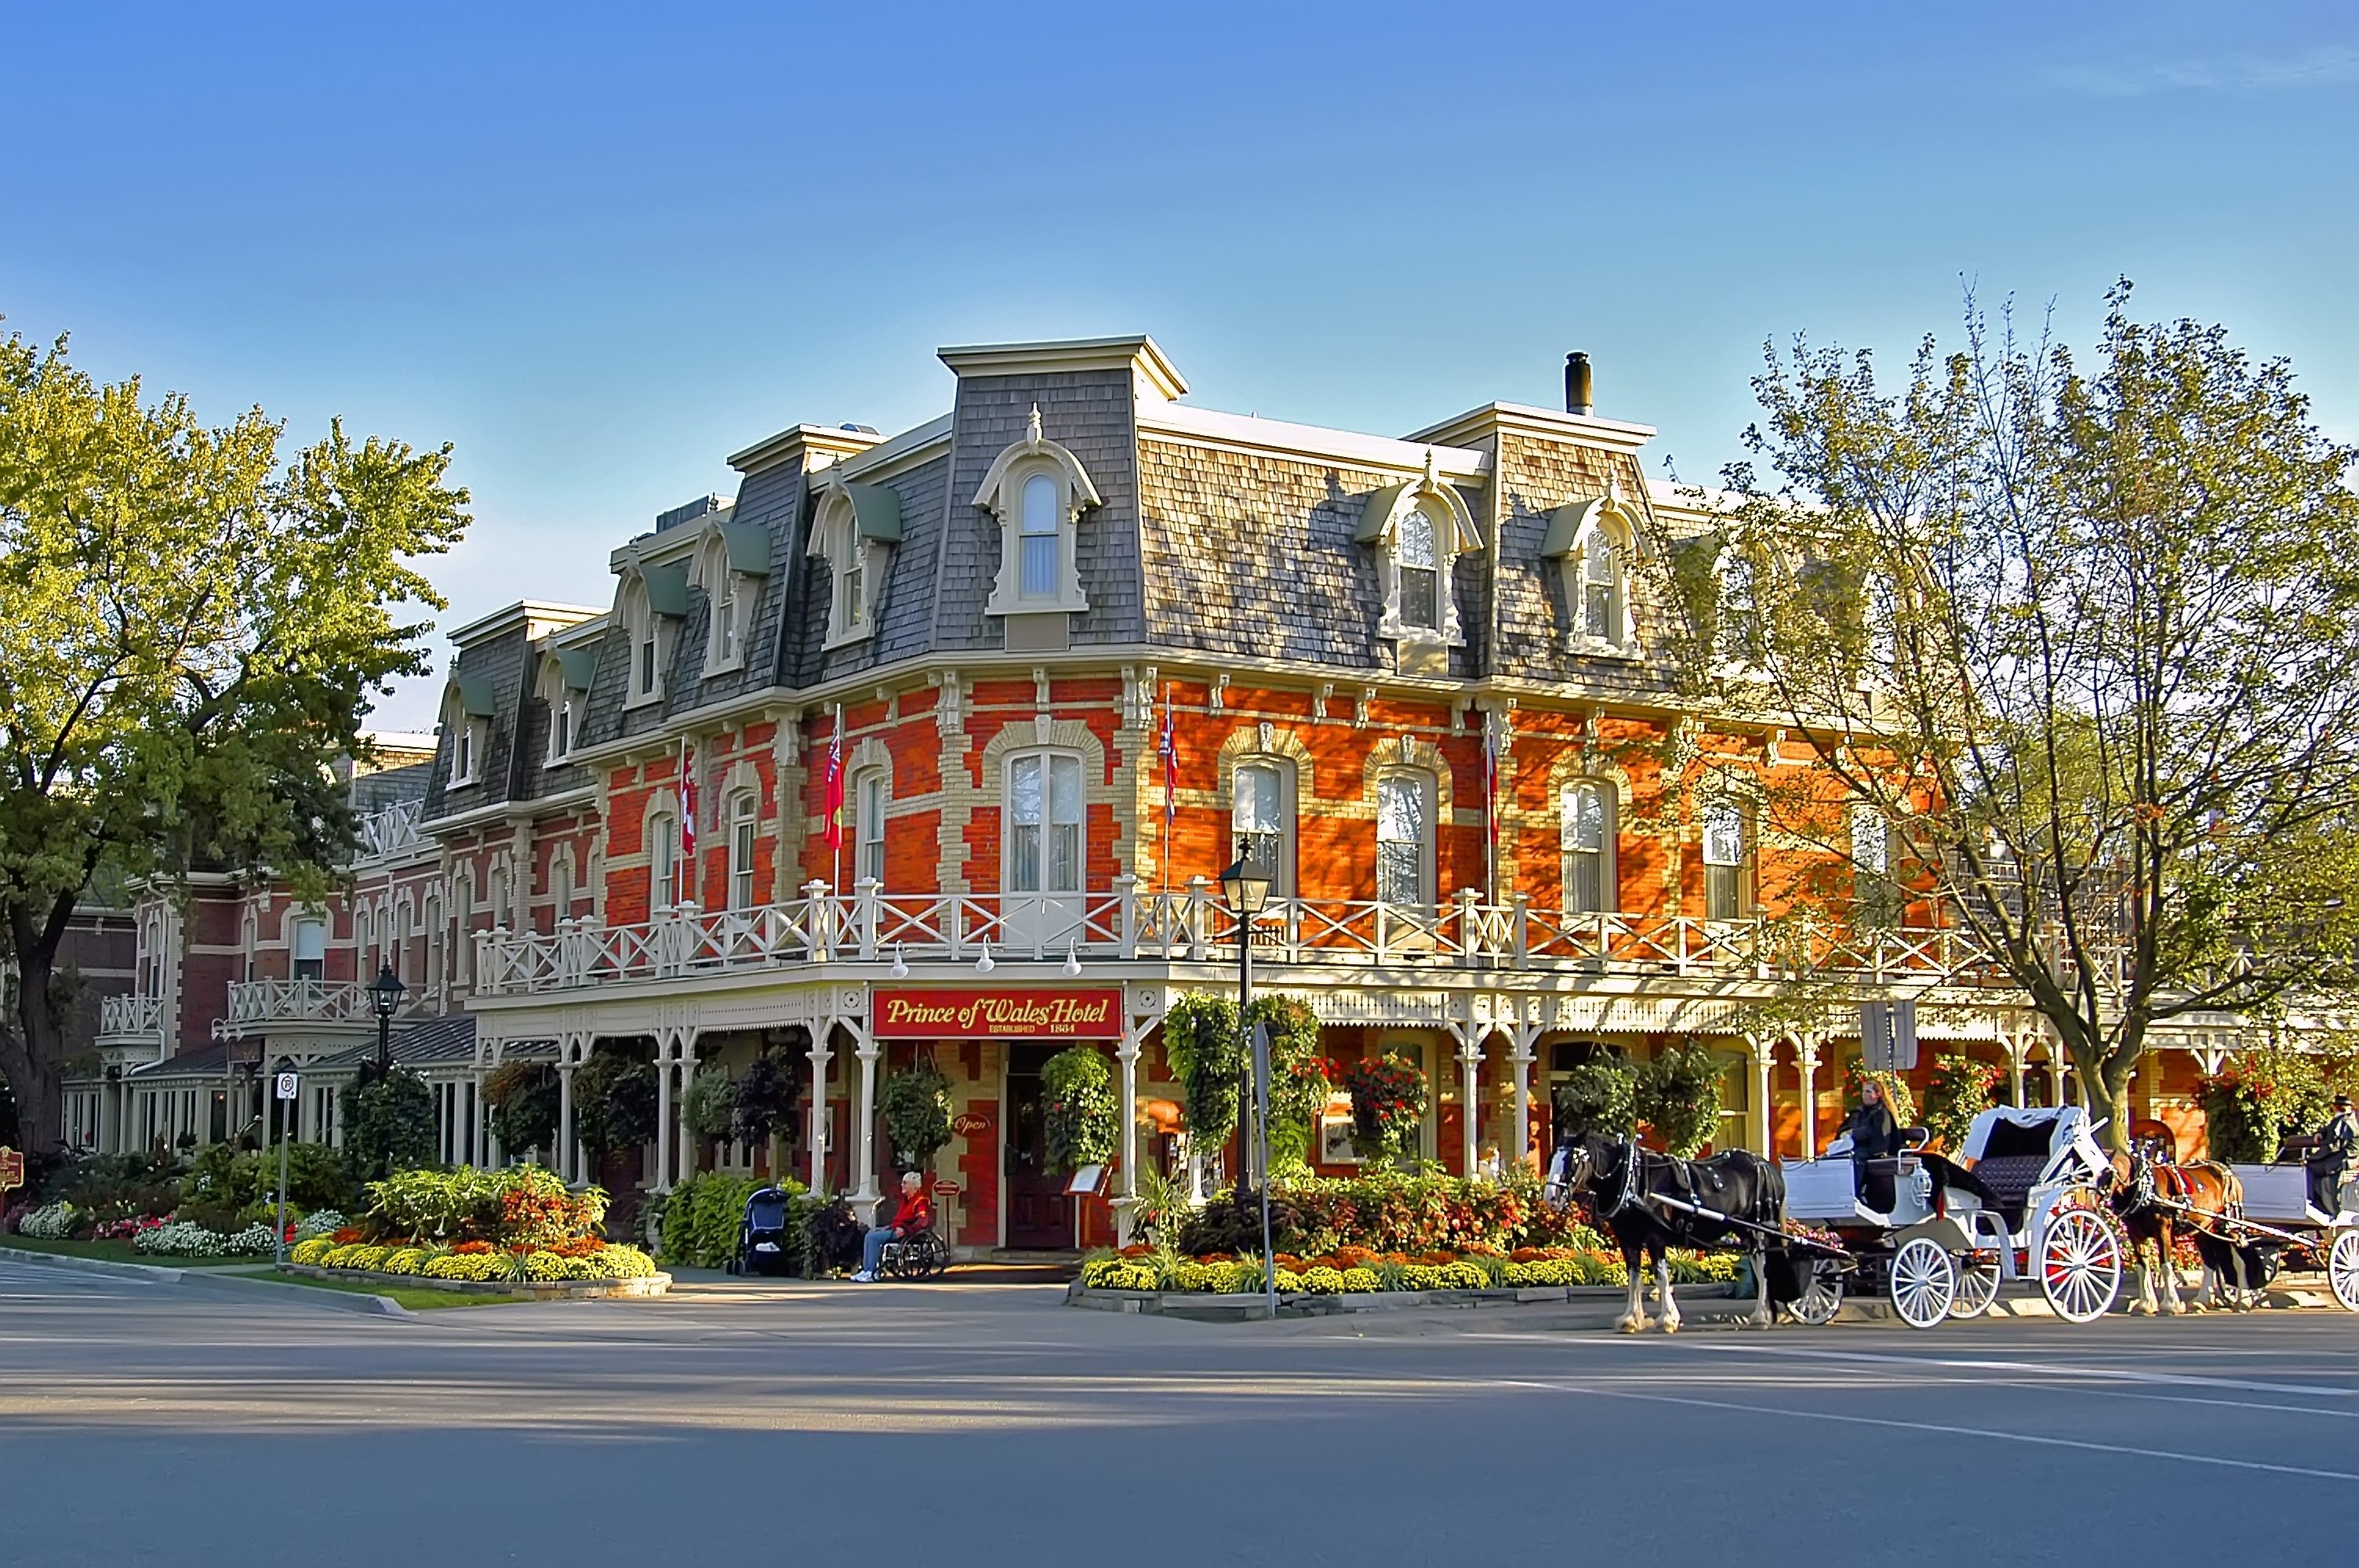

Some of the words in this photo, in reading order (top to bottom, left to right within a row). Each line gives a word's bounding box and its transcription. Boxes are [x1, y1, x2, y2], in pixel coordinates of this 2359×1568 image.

[887, 999, 954, 1022] Prince
[958, 998, 985, 1029] of
[982, 998, 1049, 1025] Wales
[1049, 999, 1108, 1022] Hotel
[989, 1025, 1035, 1033] ESTABLISHED
[1050, 1024, 1075, 1033] 1864
[954, 1116, 987, 1136] Open
